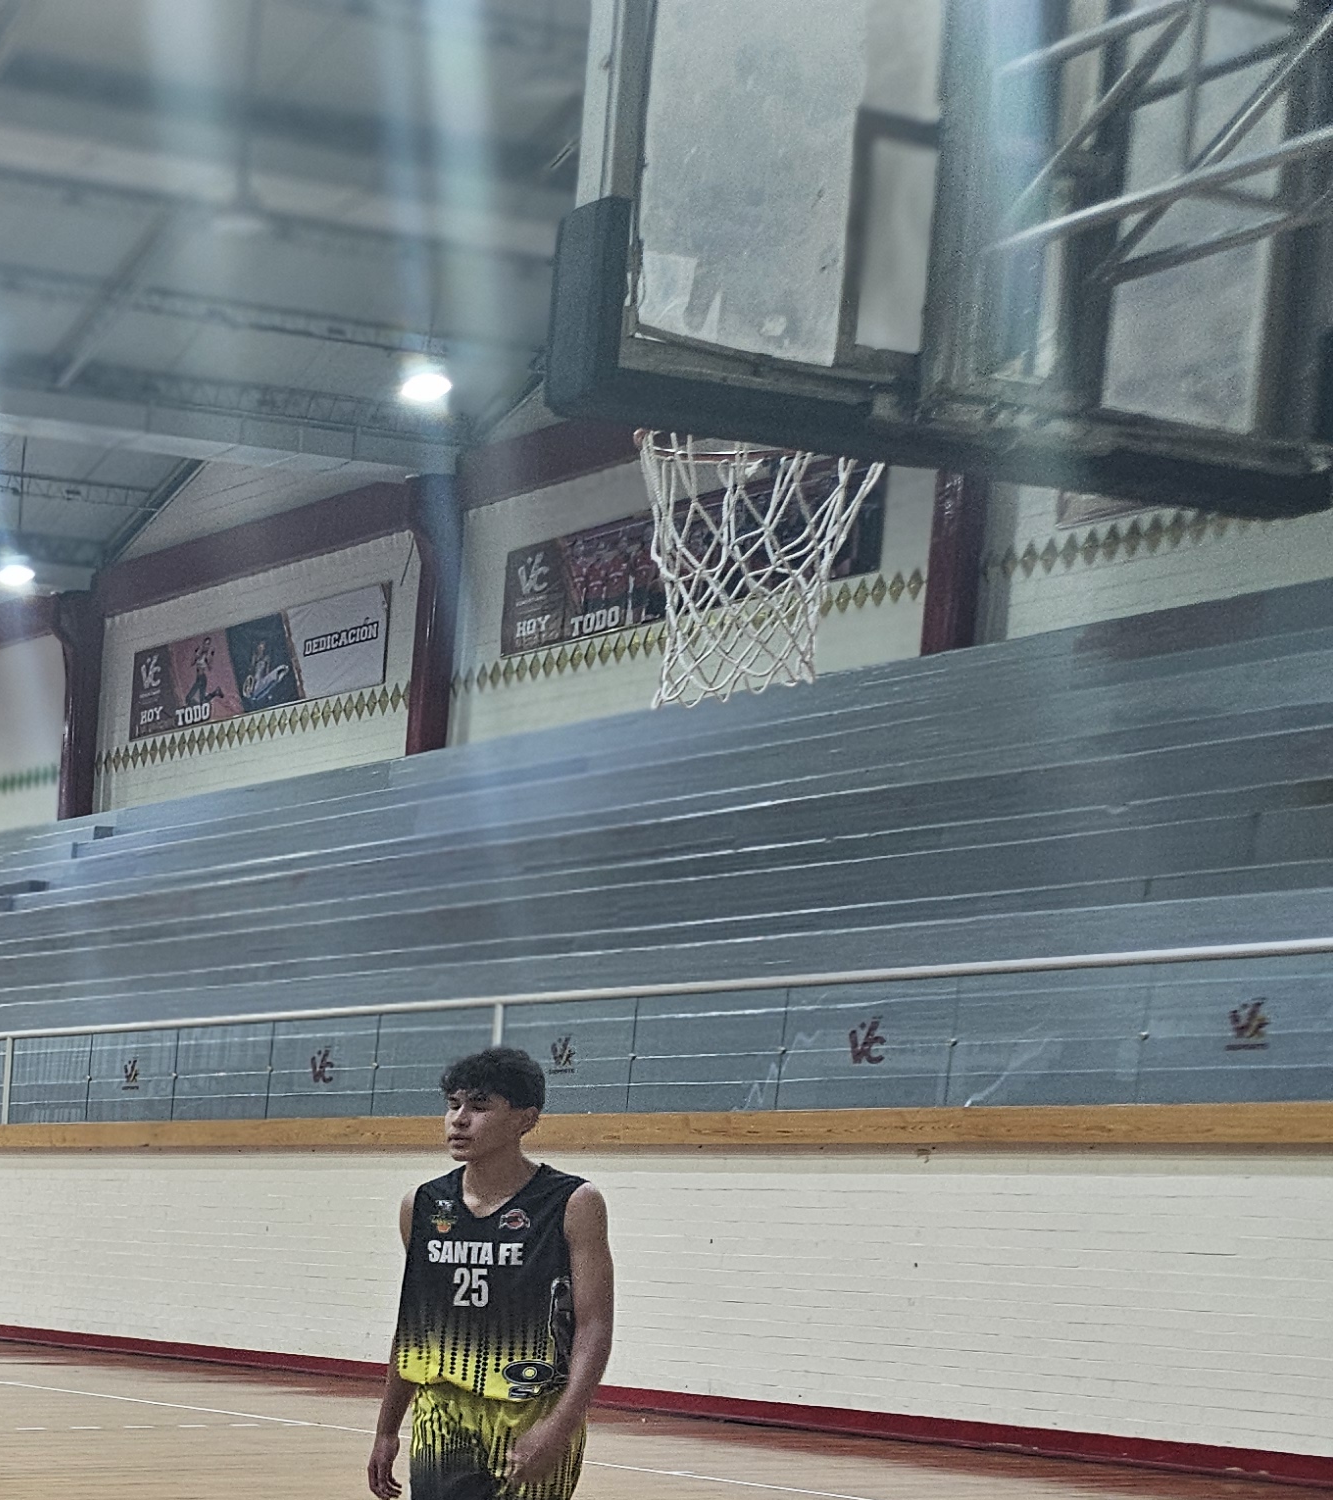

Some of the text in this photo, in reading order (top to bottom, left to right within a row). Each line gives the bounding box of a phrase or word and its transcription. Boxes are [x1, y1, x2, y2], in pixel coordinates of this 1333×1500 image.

[516, 605, 620, 637] HOY TODO
[140, 703, 211, 726] HOY TODO
[427, 1240, 524, 1266] SANTA FE
[453, 1267, 489, 1308] 25
